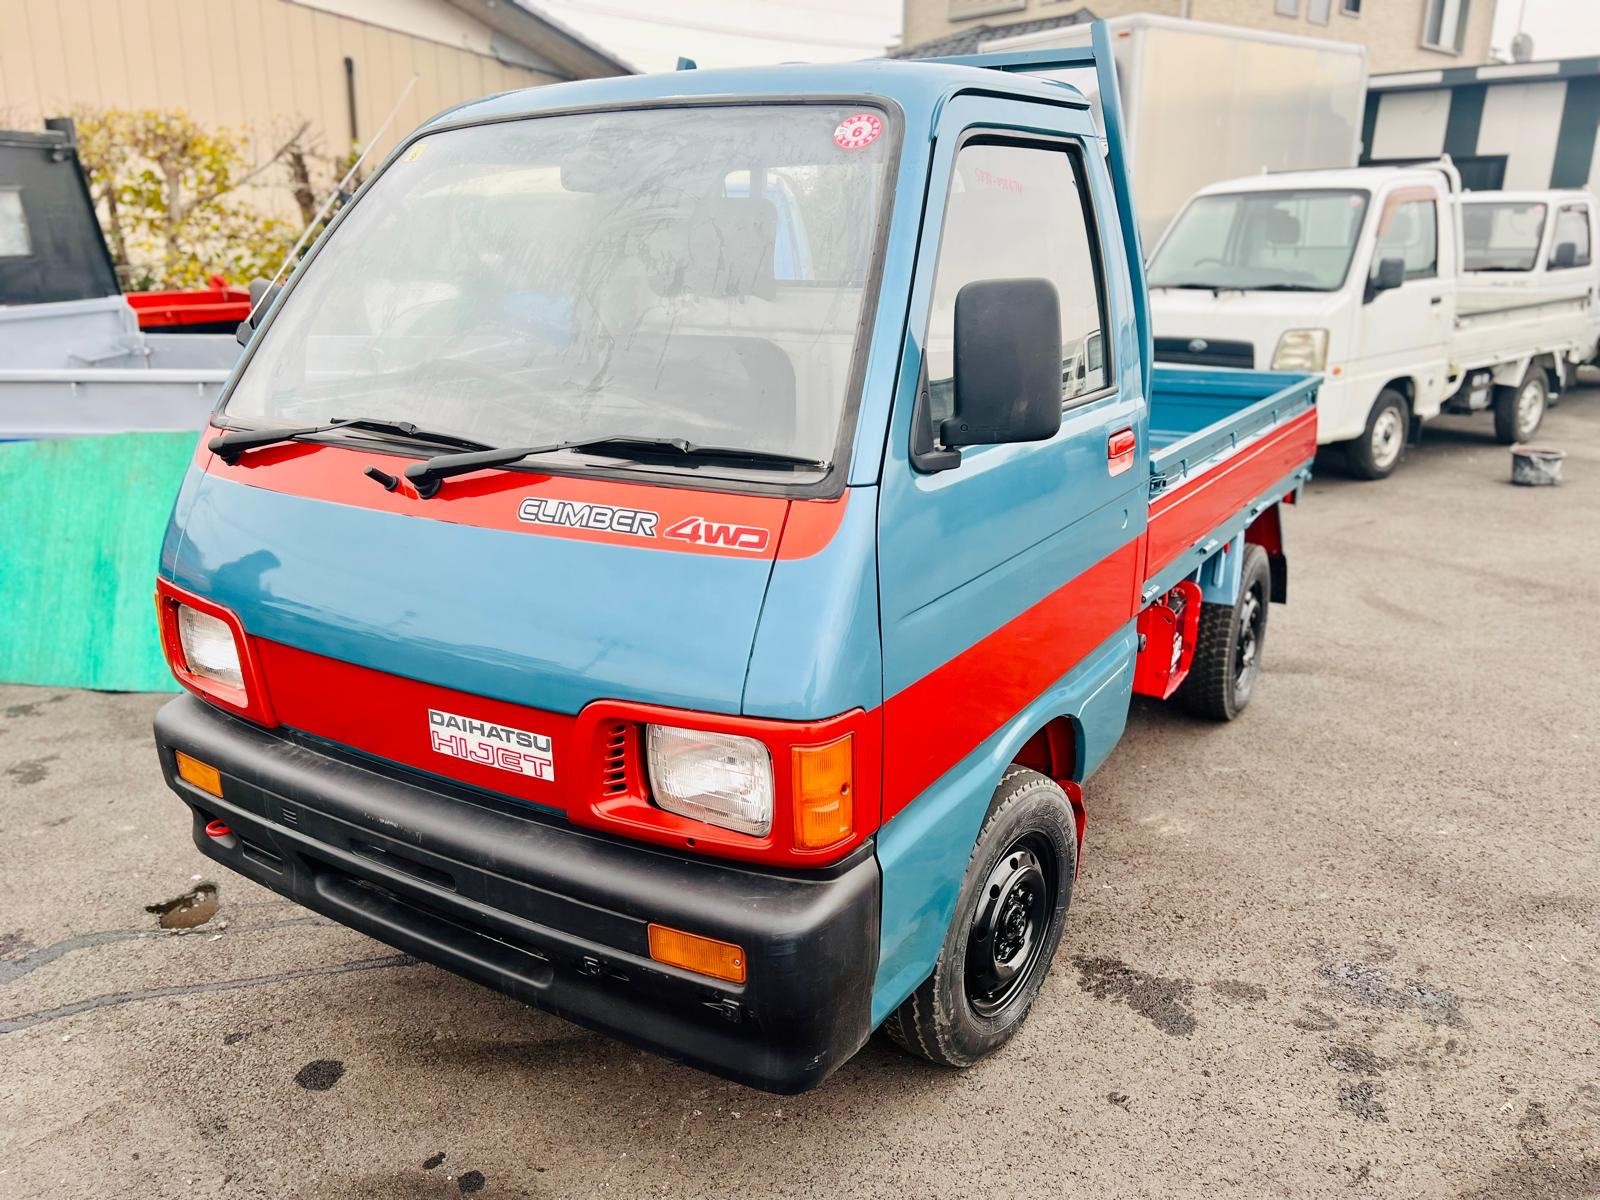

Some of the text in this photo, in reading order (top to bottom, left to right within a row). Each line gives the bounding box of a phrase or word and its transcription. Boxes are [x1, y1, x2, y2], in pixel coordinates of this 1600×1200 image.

[852, 126, 863, 137] 6
[518, 498, 769, 552] CLIMBER 4WD
[429, 710, 551, 753] DAIHATSU
[432, 730, 551, 778] HIJET
